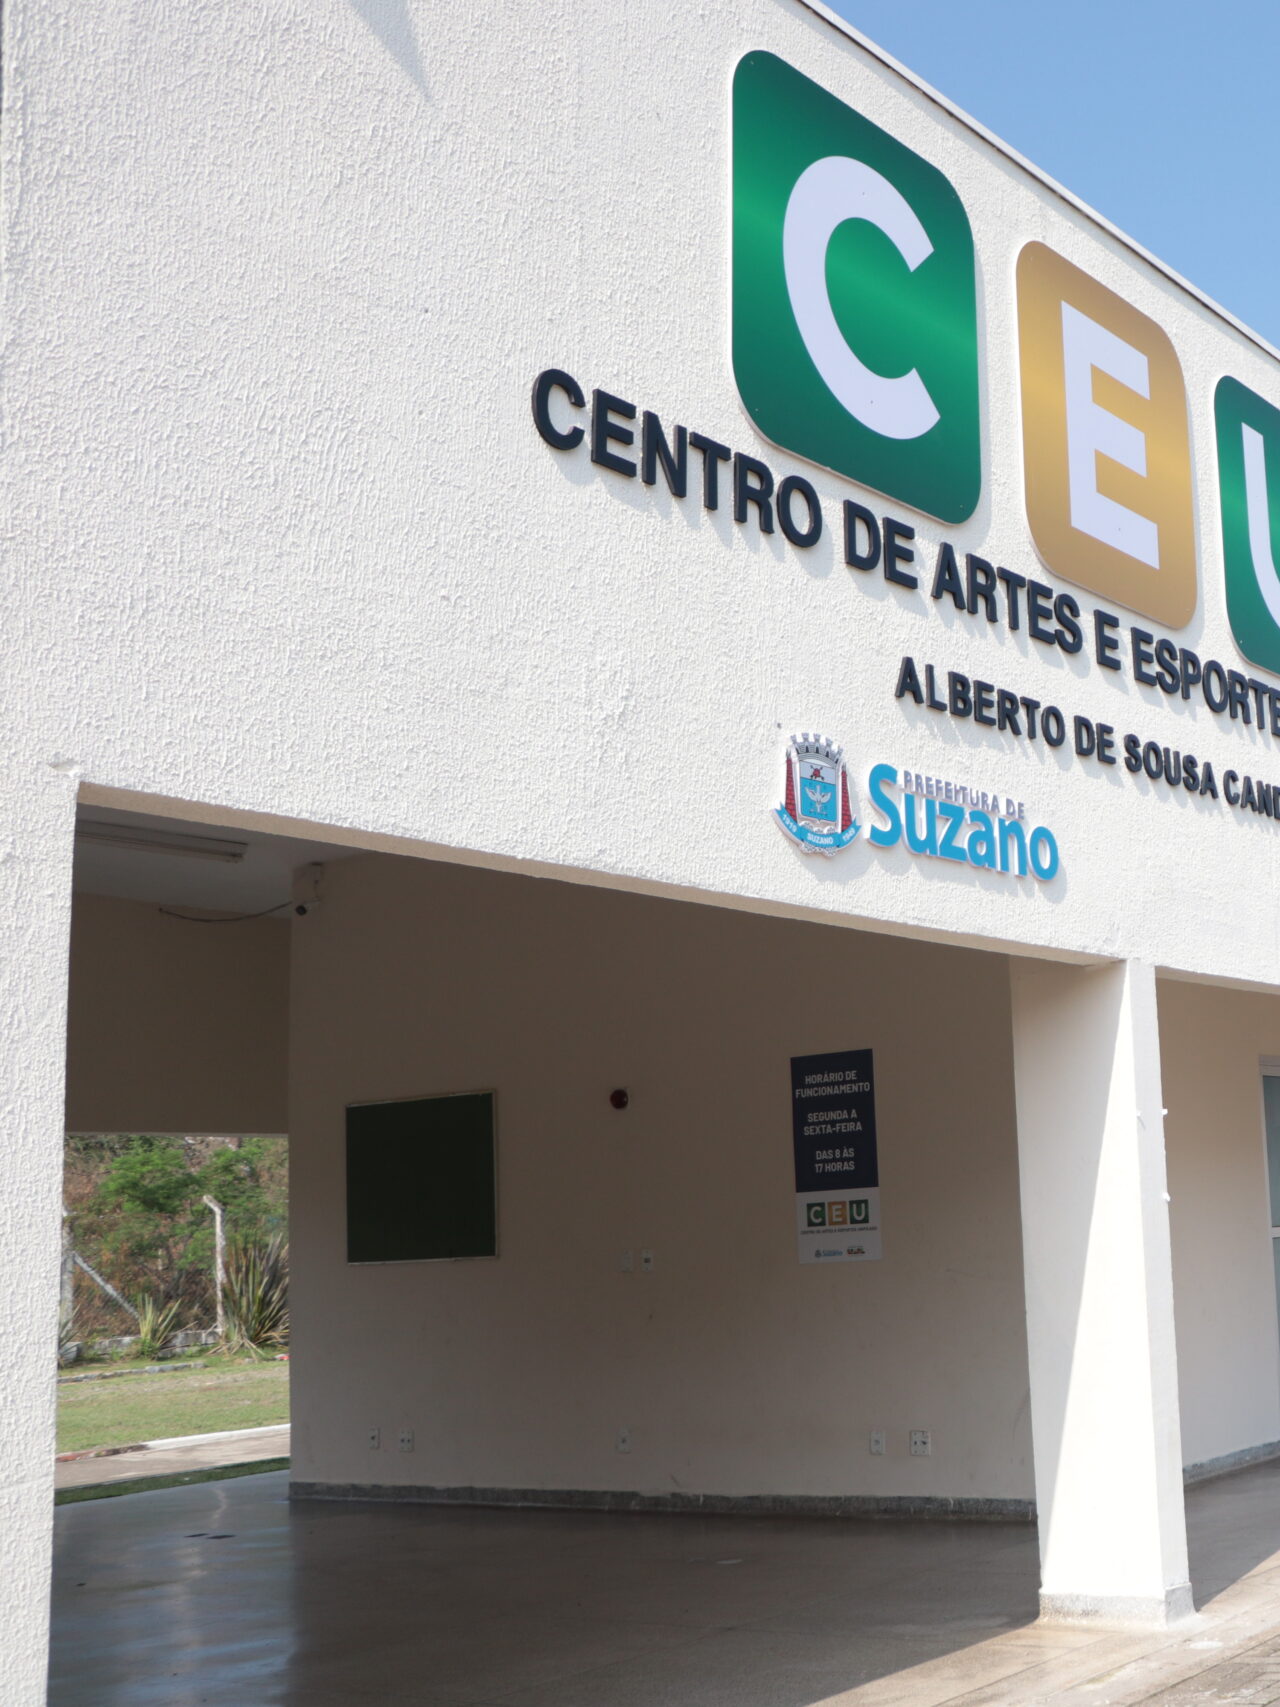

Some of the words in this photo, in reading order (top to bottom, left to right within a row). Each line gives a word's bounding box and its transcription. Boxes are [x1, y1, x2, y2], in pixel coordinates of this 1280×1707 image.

[531, 368, 823, 548] CENTRO
[844, 499, 918, 590] DE
[931, 542, 1083, 654] ARTES
[1094, 609, 1122, 671] E
[895, 656, 1066, 748] ALBERTO
[1074, 715, 1116, 765] DE
[1124, 734, 1218, 799] SOUSA
[903, 769, 1000, 814] PREFEITURA
[1005, 798, 1025, 820] DE
[868, 763, 1060, 881] Suzano
[806, 831, 834, 846] SUZANO
[805, 1071, 844, 1085] HORÁRIO
[845, 1070, 857, 1081] DE
[795, 1081, 870, 1098] FUNCIONAMENTO
[807, 1110, 849, 1123] SEGUNDA
[851, 1108, 857, 1119] A
[804, 1121, 862, 1136] SEXTA-FEIRA
[816, 1149, 834, 1160] DAS
[835, 1149, 841, 1159] 8
[842, 1146, 854, 1158] ÀS
[815, 1162, 823, 1173] 17
[825, 1160, 855, 1173] HORAS
[810, 1203, 866, 1223] CEU
